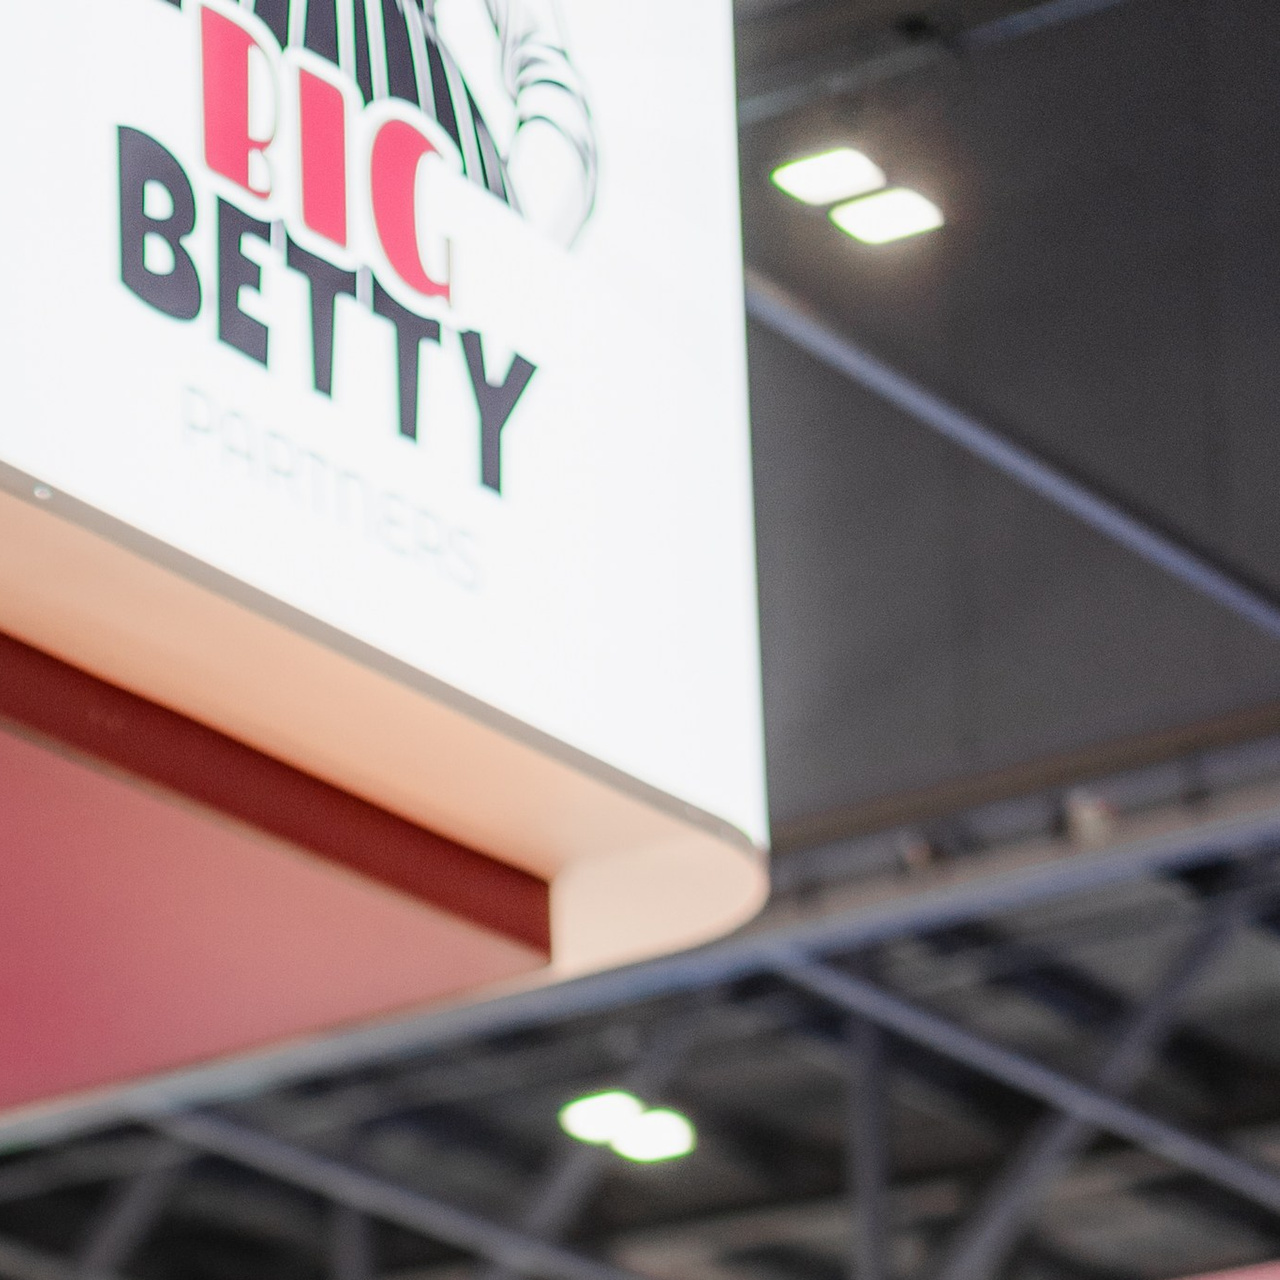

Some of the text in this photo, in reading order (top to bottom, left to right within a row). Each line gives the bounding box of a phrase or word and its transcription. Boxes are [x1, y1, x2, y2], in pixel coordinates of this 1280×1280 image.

[200, 4, 451, 304] BIG
[117, 124, 538, 498] BETTY
[179, 382, 487, 594] PARTNERS
